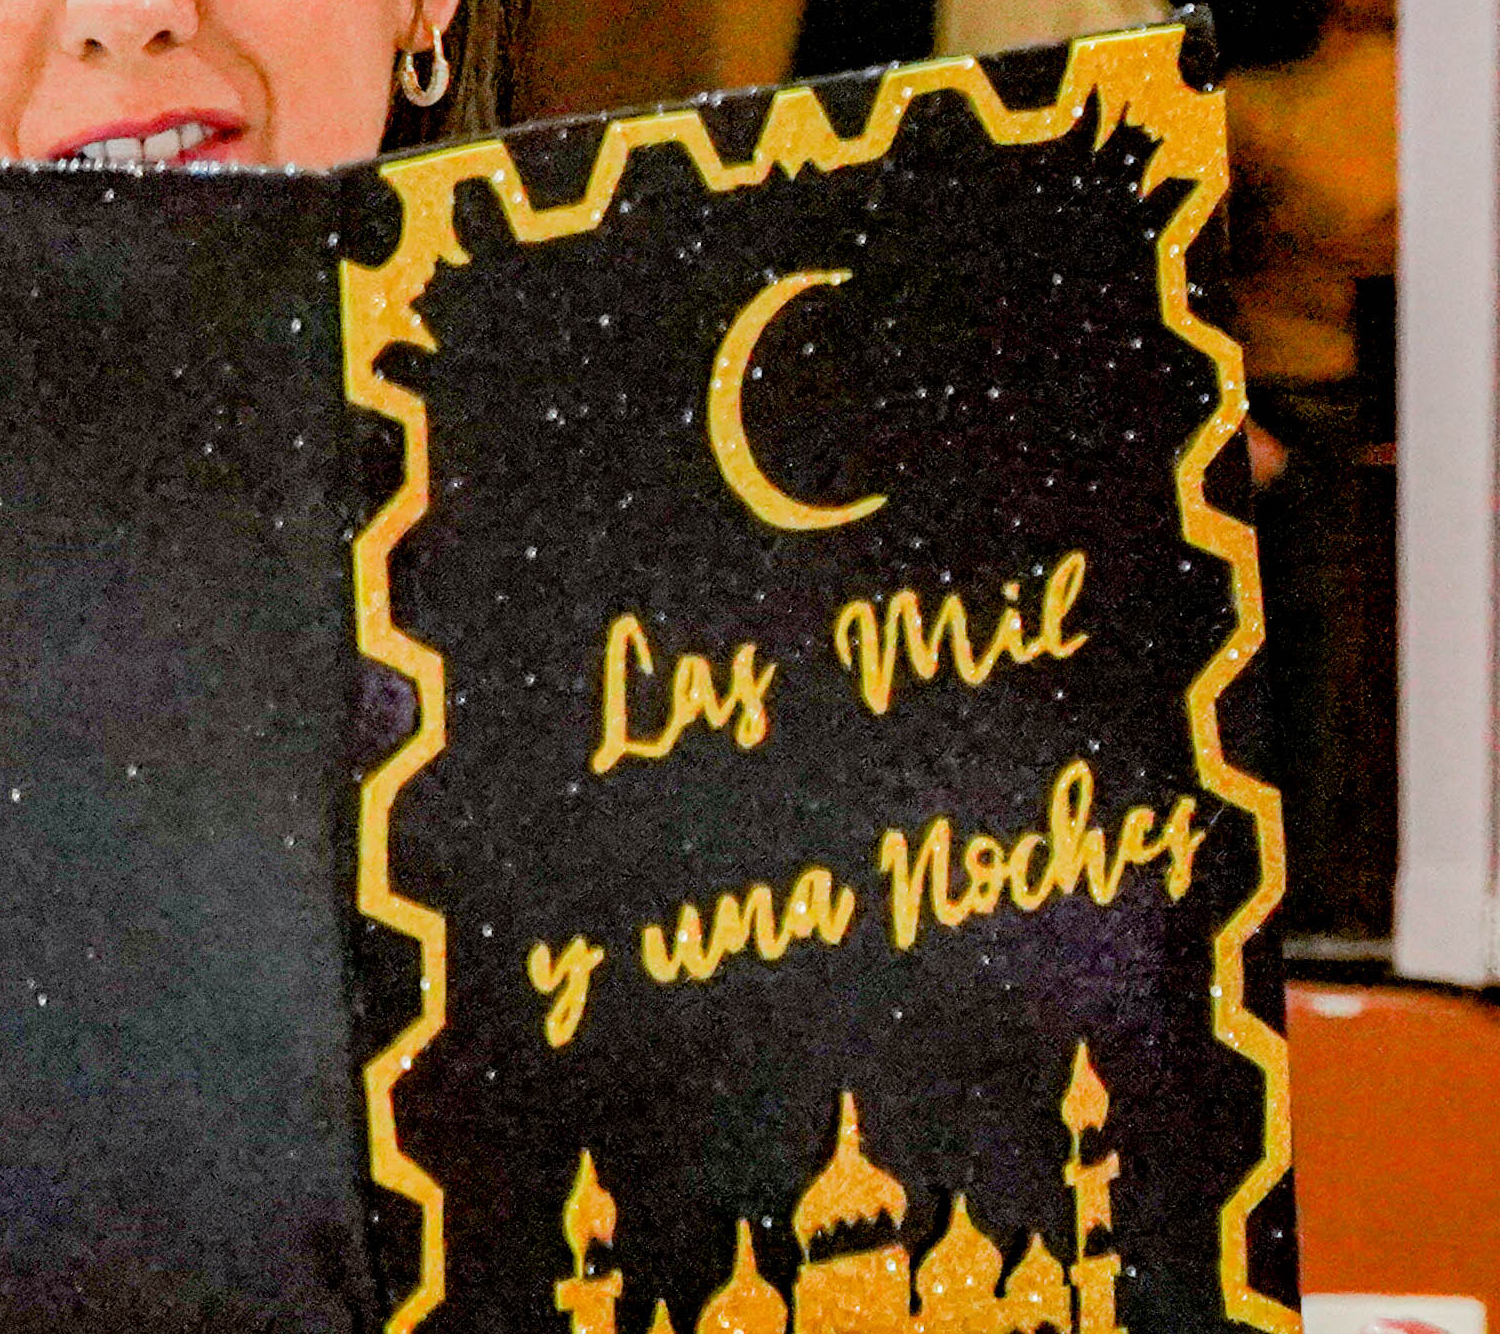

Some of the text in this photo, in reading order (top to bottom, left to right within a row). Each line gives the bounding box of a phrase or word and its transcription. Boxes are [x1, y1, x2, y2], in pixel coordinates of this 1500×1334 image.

[591, 552, 1089, 774] Las Mil
[527, 759, 1208, 1047] y una Noches
